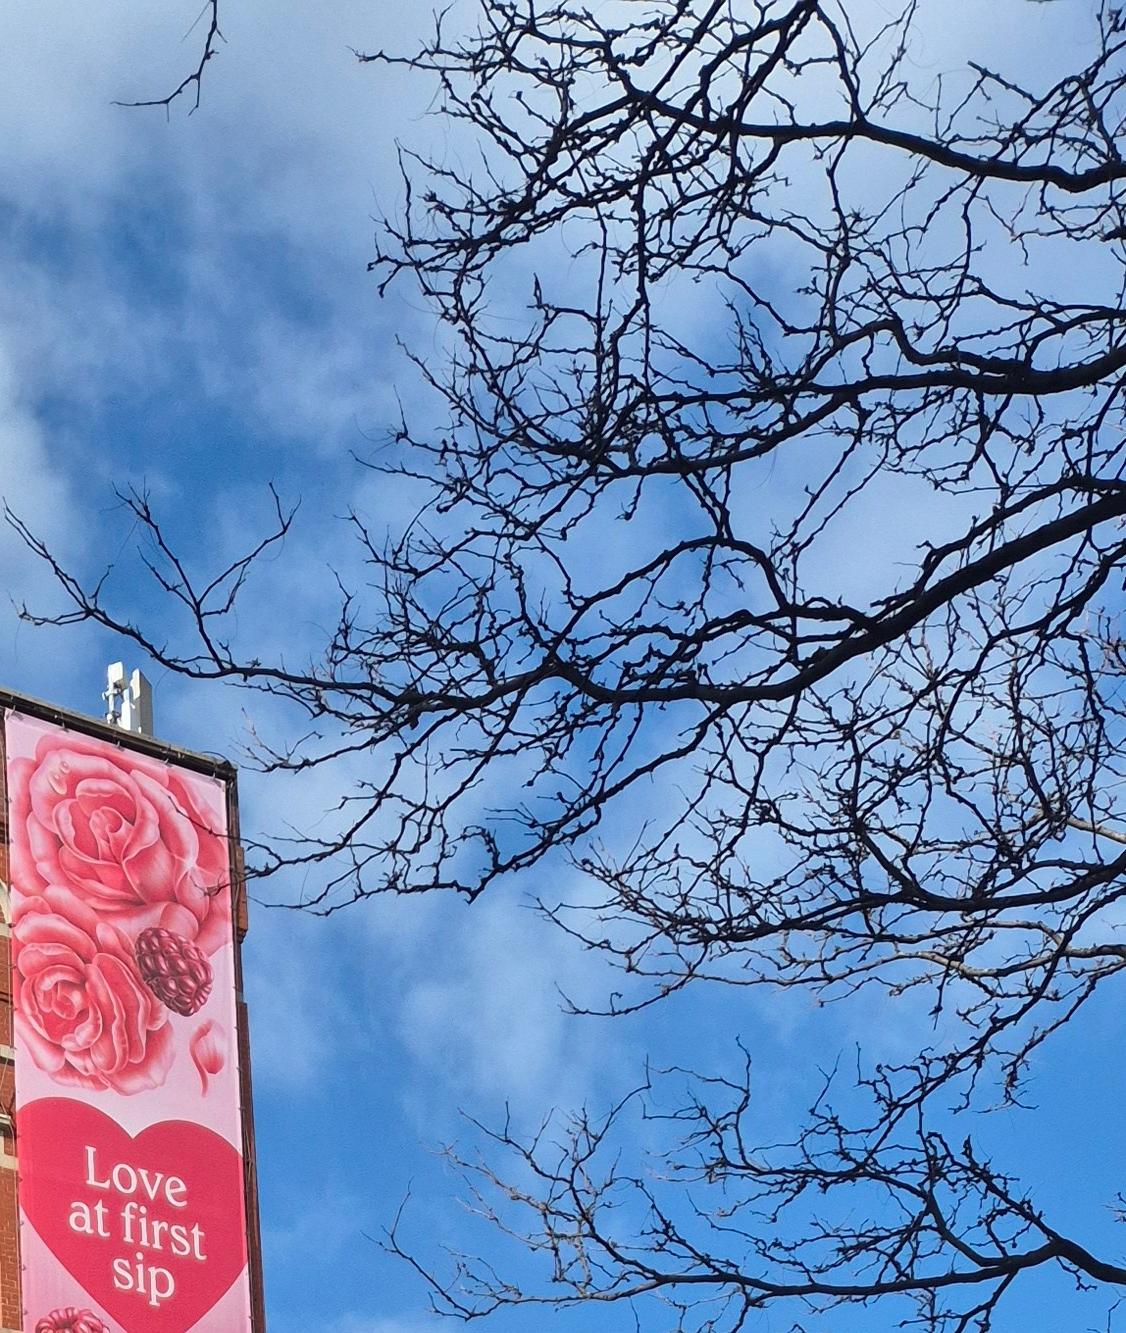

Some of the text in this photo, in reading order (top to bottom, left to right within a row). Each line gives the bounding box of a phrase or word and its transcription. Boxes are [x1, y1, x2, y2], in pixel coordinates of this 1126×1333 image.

[85, 1146, 187, 1207] Love
[69, 1199, 207, 1260] at first
[113, 1252, 174, 1306] sip
